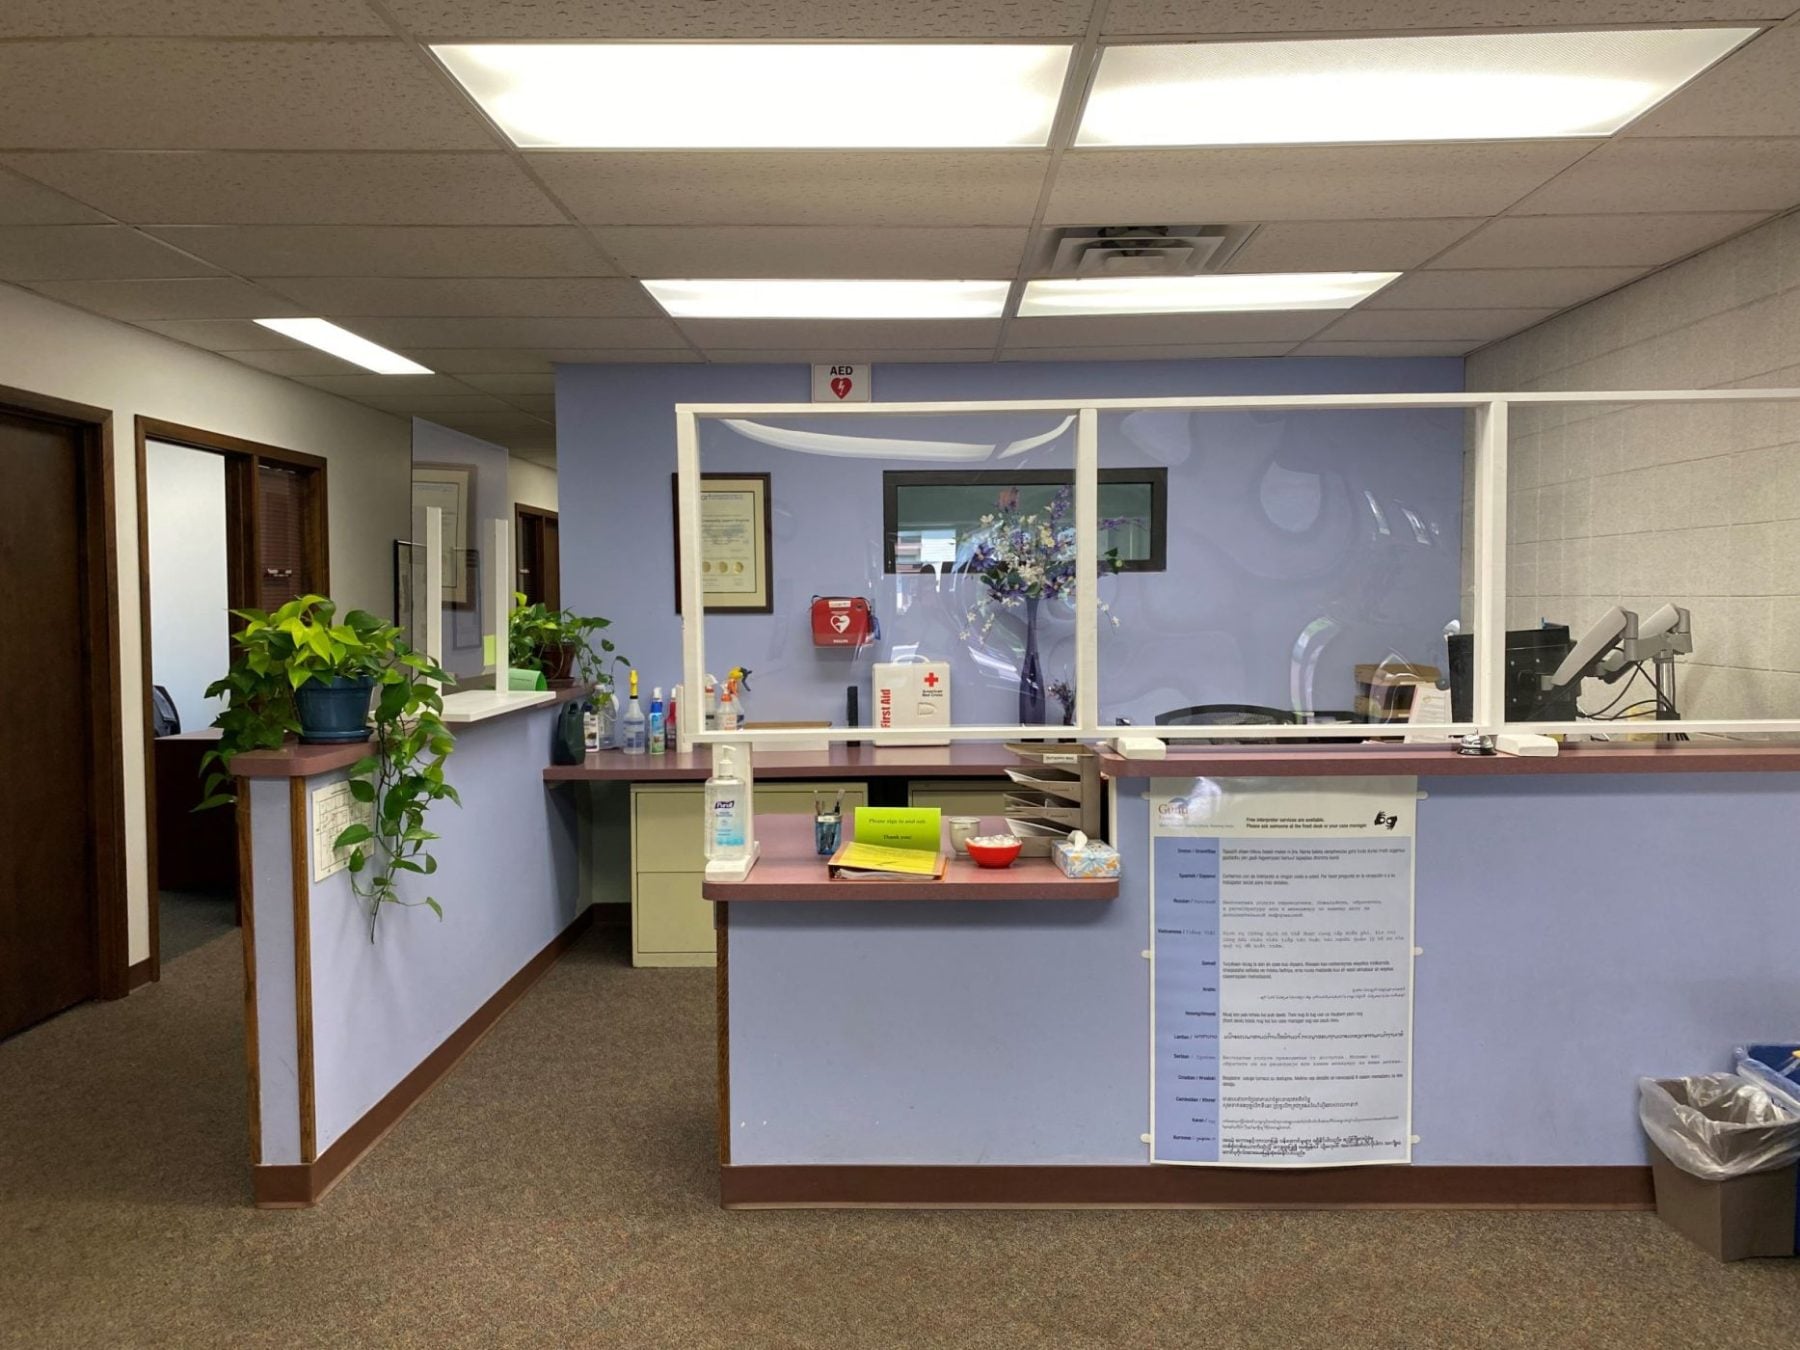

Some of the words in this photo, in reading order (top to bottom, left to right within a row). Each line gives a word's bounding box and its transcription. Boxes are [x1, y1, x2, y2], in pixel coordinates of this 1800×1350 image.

[830, 365, 853, 376] AED
[880, 689, 891, 705] Aid
[880, 707, 891, 728] First
